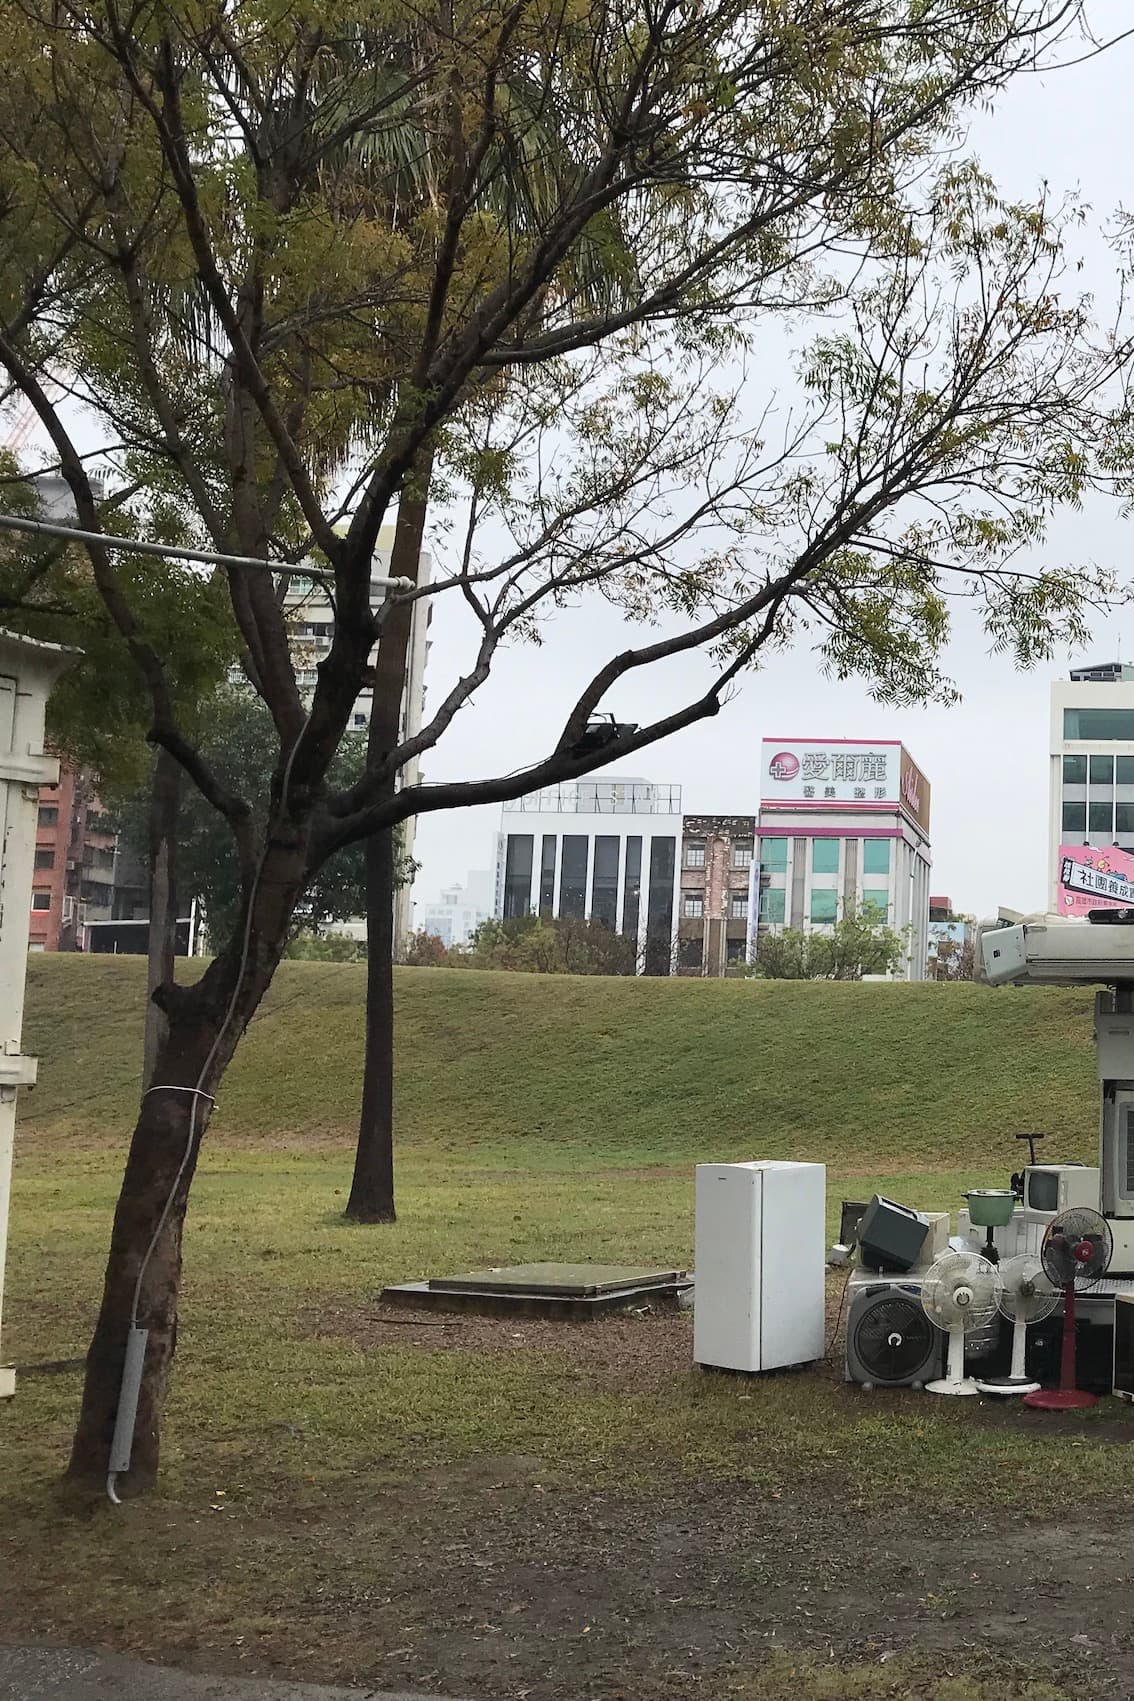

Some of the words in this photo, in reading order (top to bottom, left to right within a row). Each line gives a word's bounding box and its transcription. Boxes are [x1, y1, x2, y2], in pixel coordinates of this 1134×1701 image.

[801, 752, 887, 782] 愛爾麗
[854, 787, 887, 799] 整形
